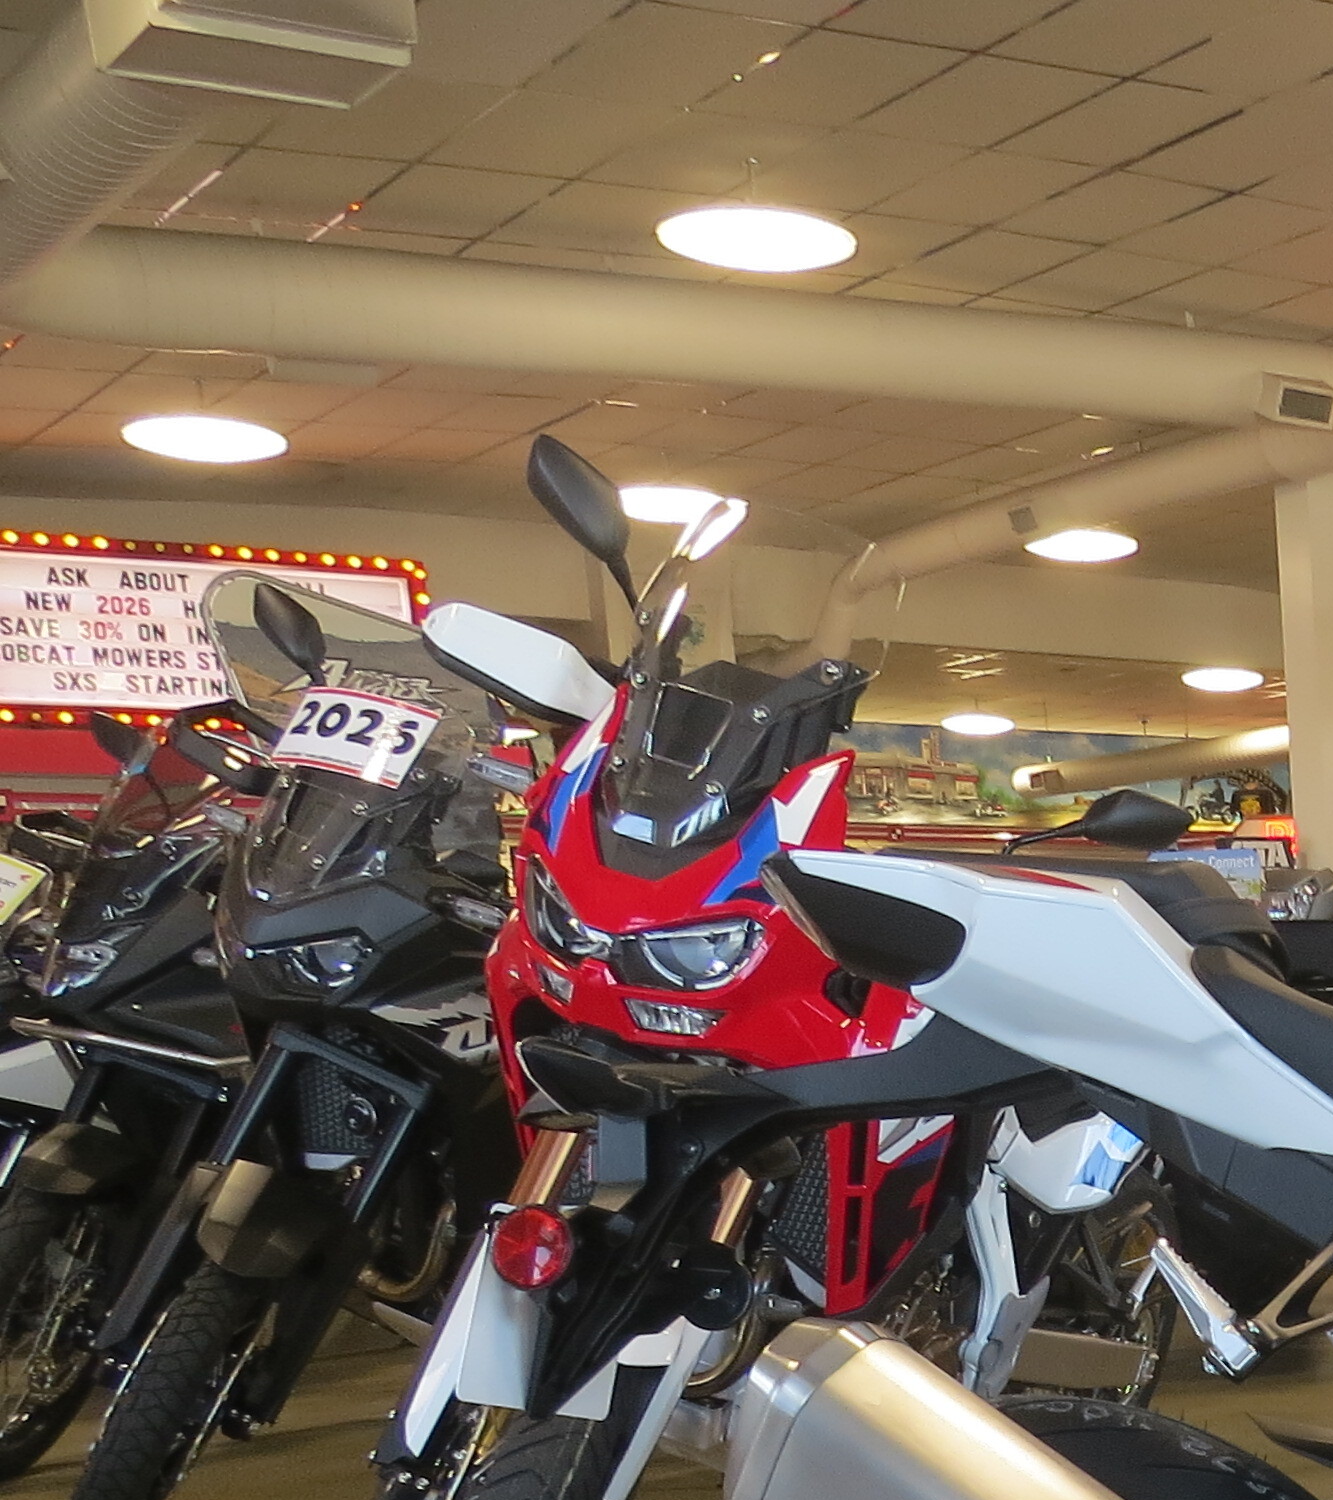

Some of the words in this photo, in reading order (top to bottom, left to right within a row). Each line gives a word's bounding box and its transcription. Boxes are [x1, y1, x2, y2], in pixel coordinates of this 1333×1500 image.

[47, 566, 91, 588] ASK
[118, 570, 190, 593] ABOUT
[24, 590, 72, 612] NEW
[96, 595, 151, 616] 2026
[0, 616, 61, 638] SAVE
[79, 620, 123, 641] 30%
[138, 623, 168, 643] ON
[0, 643, 75, 666] OBCAT
[92, 647, 187, 670] MOWERS
[53, 671, 97, 692] SXS
